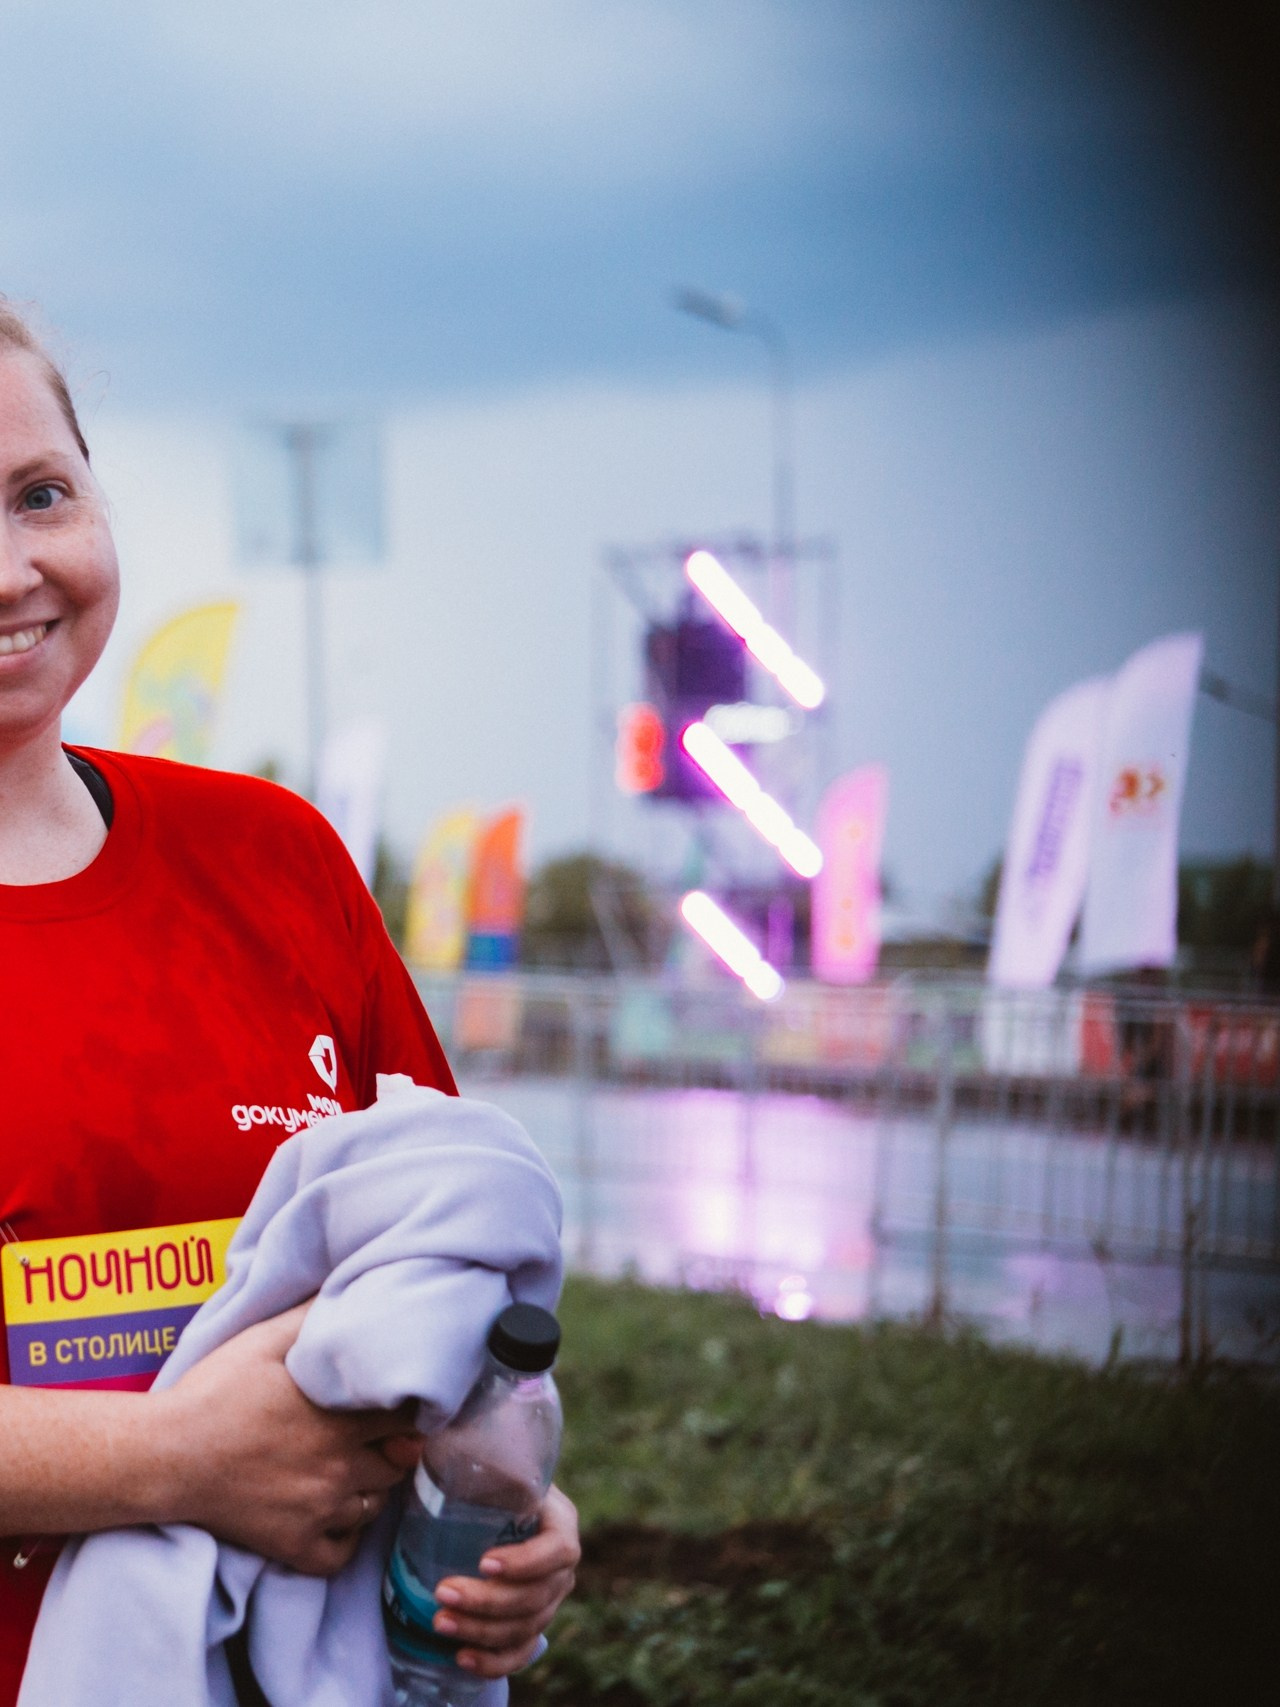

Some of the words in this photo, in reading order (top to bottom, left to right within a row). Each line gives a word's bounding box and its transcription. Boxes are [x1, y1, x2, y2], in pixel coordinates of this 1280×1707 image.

[231, 1104, 326, 1133] докуме
[23, 1235, 214, 1305] НОЧНОЙ
[28, 1341, 47, 1366] В
[55, 1326, 176, 1365] СТОЛИЦЕ
